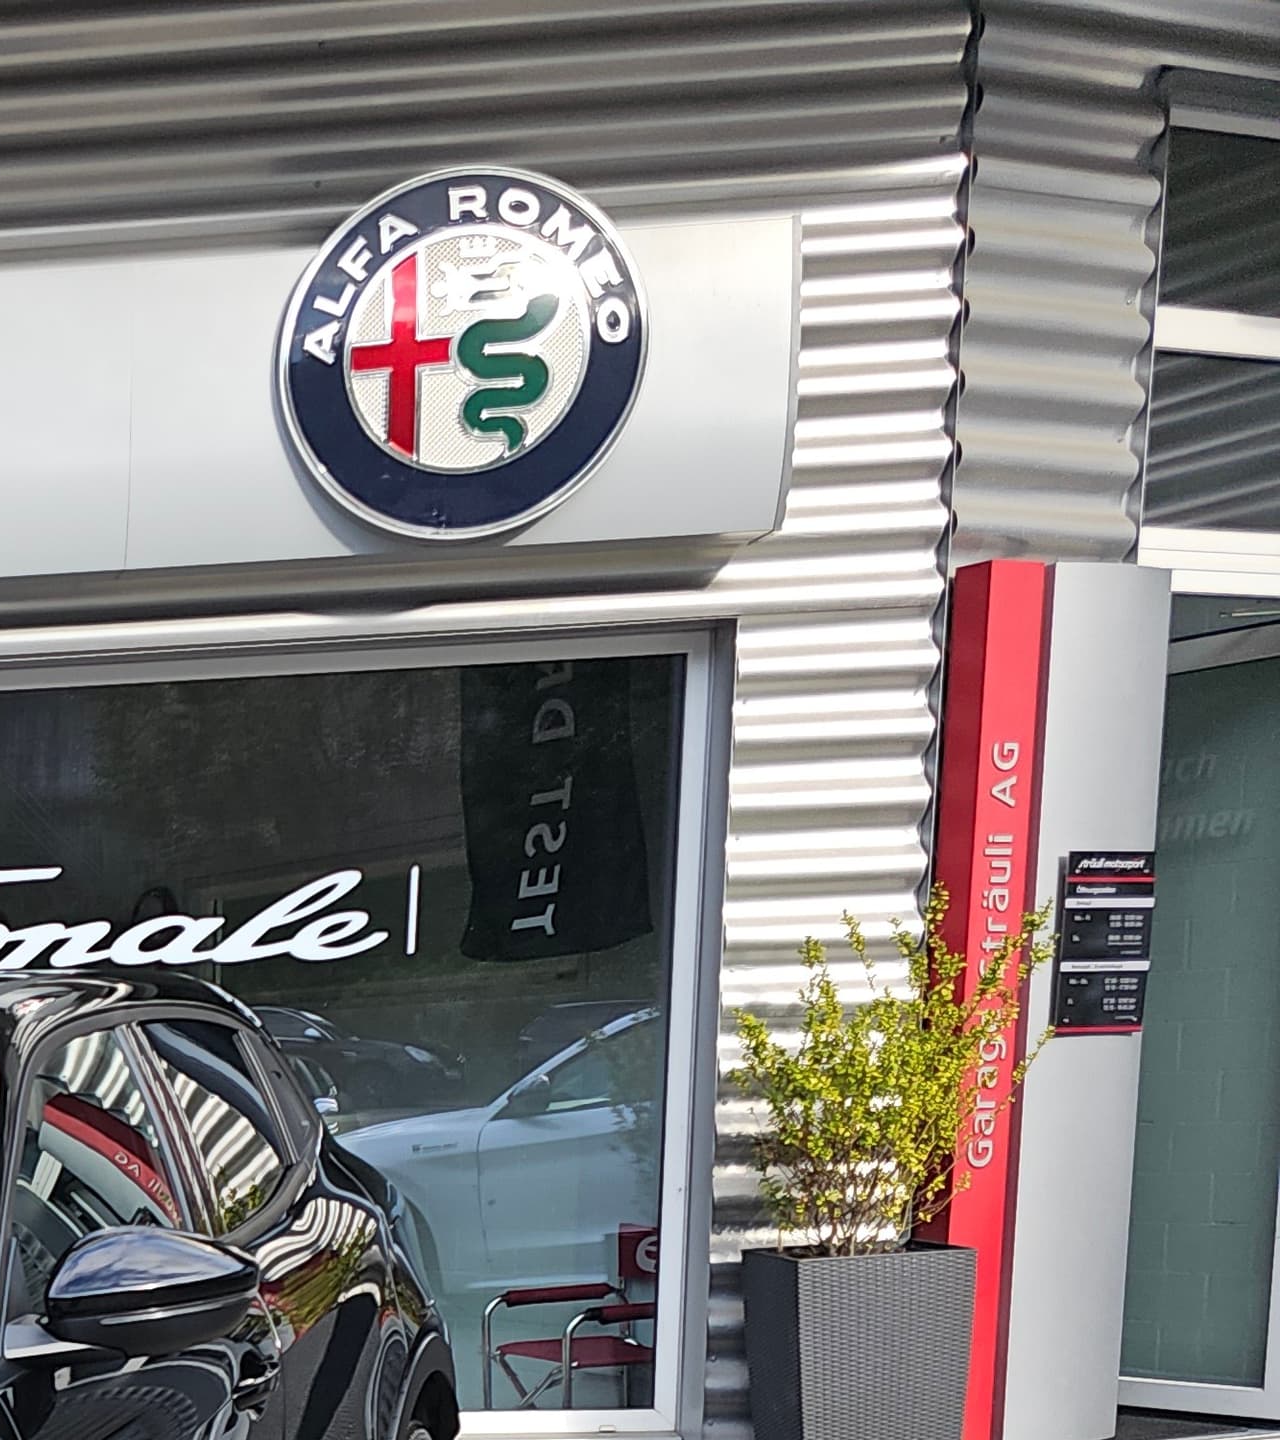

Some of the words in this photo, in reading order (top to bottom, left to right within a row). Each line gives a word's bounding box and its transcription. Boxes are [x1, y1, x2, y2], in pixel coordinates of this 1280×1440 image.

[303, 212, 420, 366] ALFA
[447, 185, 631, 345] ROMEO
[991, 741, 1021, 808] AG
